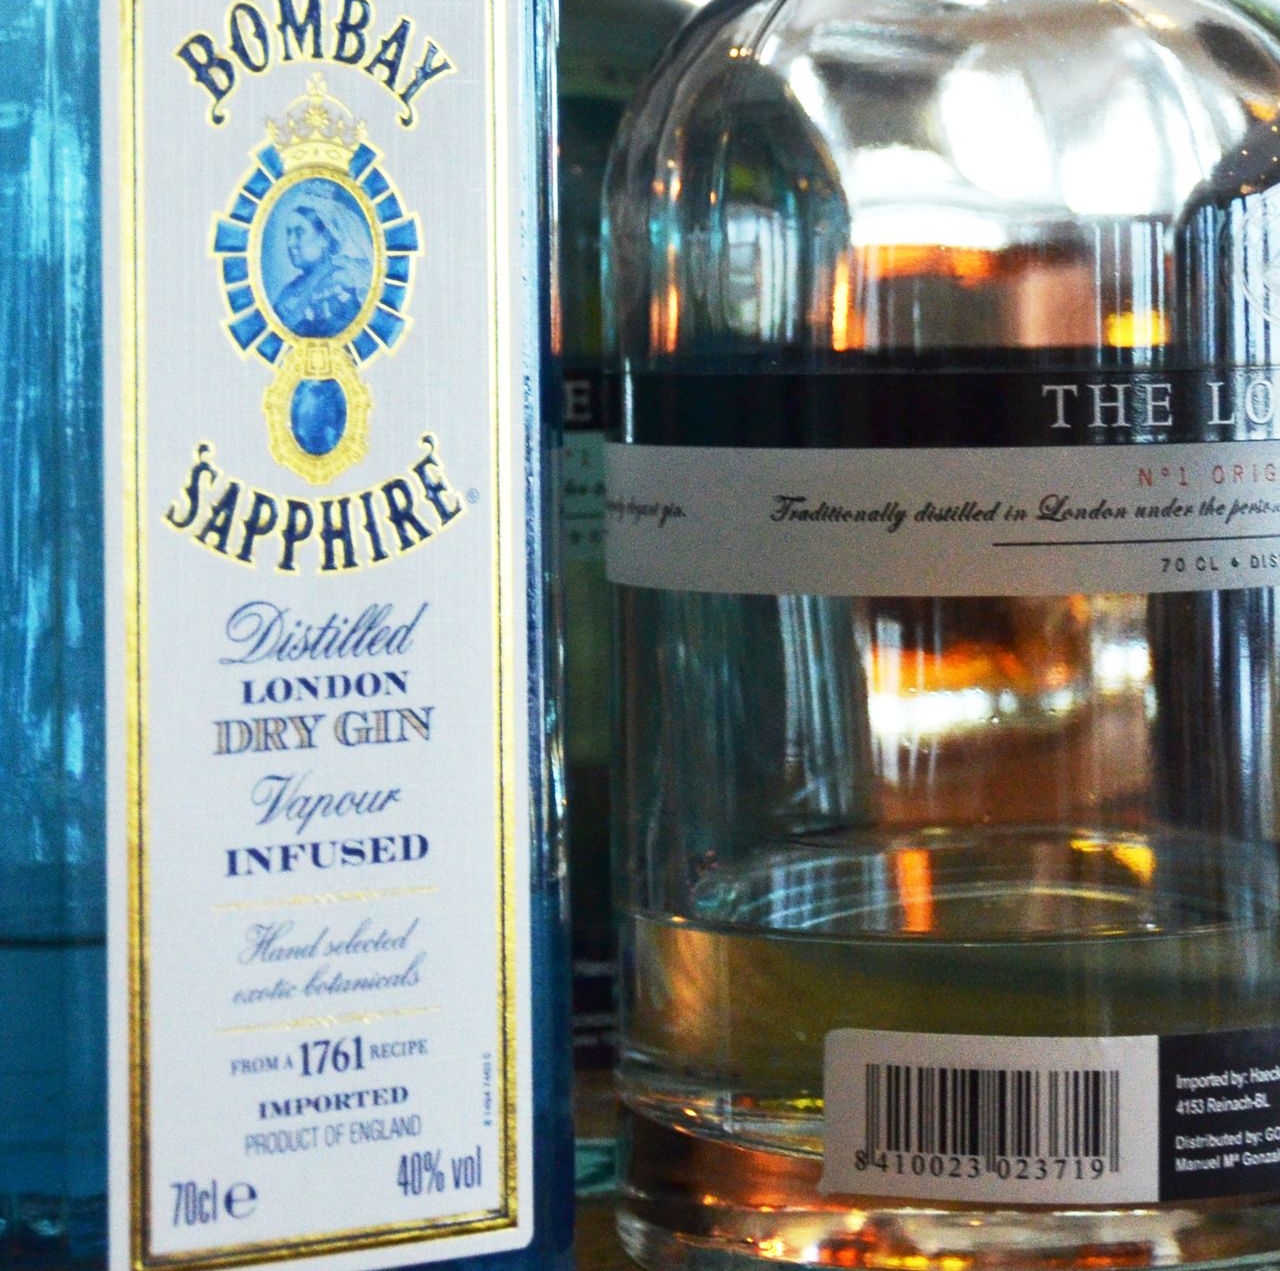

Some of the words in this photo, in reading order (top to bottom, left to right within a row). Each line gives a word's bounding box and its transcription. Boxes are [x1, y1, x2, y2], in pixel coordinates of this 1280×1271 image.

[1042, 382, 1172, 429] THE
[167, 436, 462, 572] SAPPHIRE
[770, 494, 907, 534] Traditionally
[913, 501, 1001, 523] distilled
[1004, 504, 1027, 522] in
[1037, 493, 1130, 522] London
[1134, 496, 1194, 519] under
[1197, 496, 1224, 518] the
[1161, 557, 1187, 573] 70
[1196, 556, 1219, 572] CL
[219, 600, 429, 665] Distilled
[242, 670, 410, 705] LONDON
[213, 713, 327, 755] DRY
[334, 705, 435, 747] GIN
[251, 770, 402, 836] Vapour
[225, 833, 430, 877] INFUSED
[238, 919, 330, 966] Hand
[322, 917, 420, 957] selected
[232, 978, 297, 1005] exotic
[303, 951, 428, 996] botanicals
[231, 1056, 279, 1076] FROM
[282, 1055, 295, 1071] A
[300, 1035, 366, 1078] 1761
[370, 1038, 429, 1060] RECIPE
[258, 1085, 410, 1120] IMPORTED
[1176, 1070, 1228, 1092] Imported
[1230, 1069, 1248, 1088] by:
[1176, 1098, 1205, 1116] 4153
[243, 1126, 319, 1157] PRODUCT
[324, 1122, 345, 1148] OF
[349, 1113, 423, 1145] ENGLAND
[1175, 1131, 1243, 1150] Distributed
[1245, 1129, 1263, 1146] by:
[397, 1149, 446, 1197] 40%
[451, 1144, 483, 1190] vol
[854, 1149, 869, 1172] 8
[871, 1150, 982, 1178] 410023
[995, 1158, 1105, 1181] 023719
[1175, 1157, 1221, 1172] Manuel
[170, 1178, 218, 1227] 70cl
